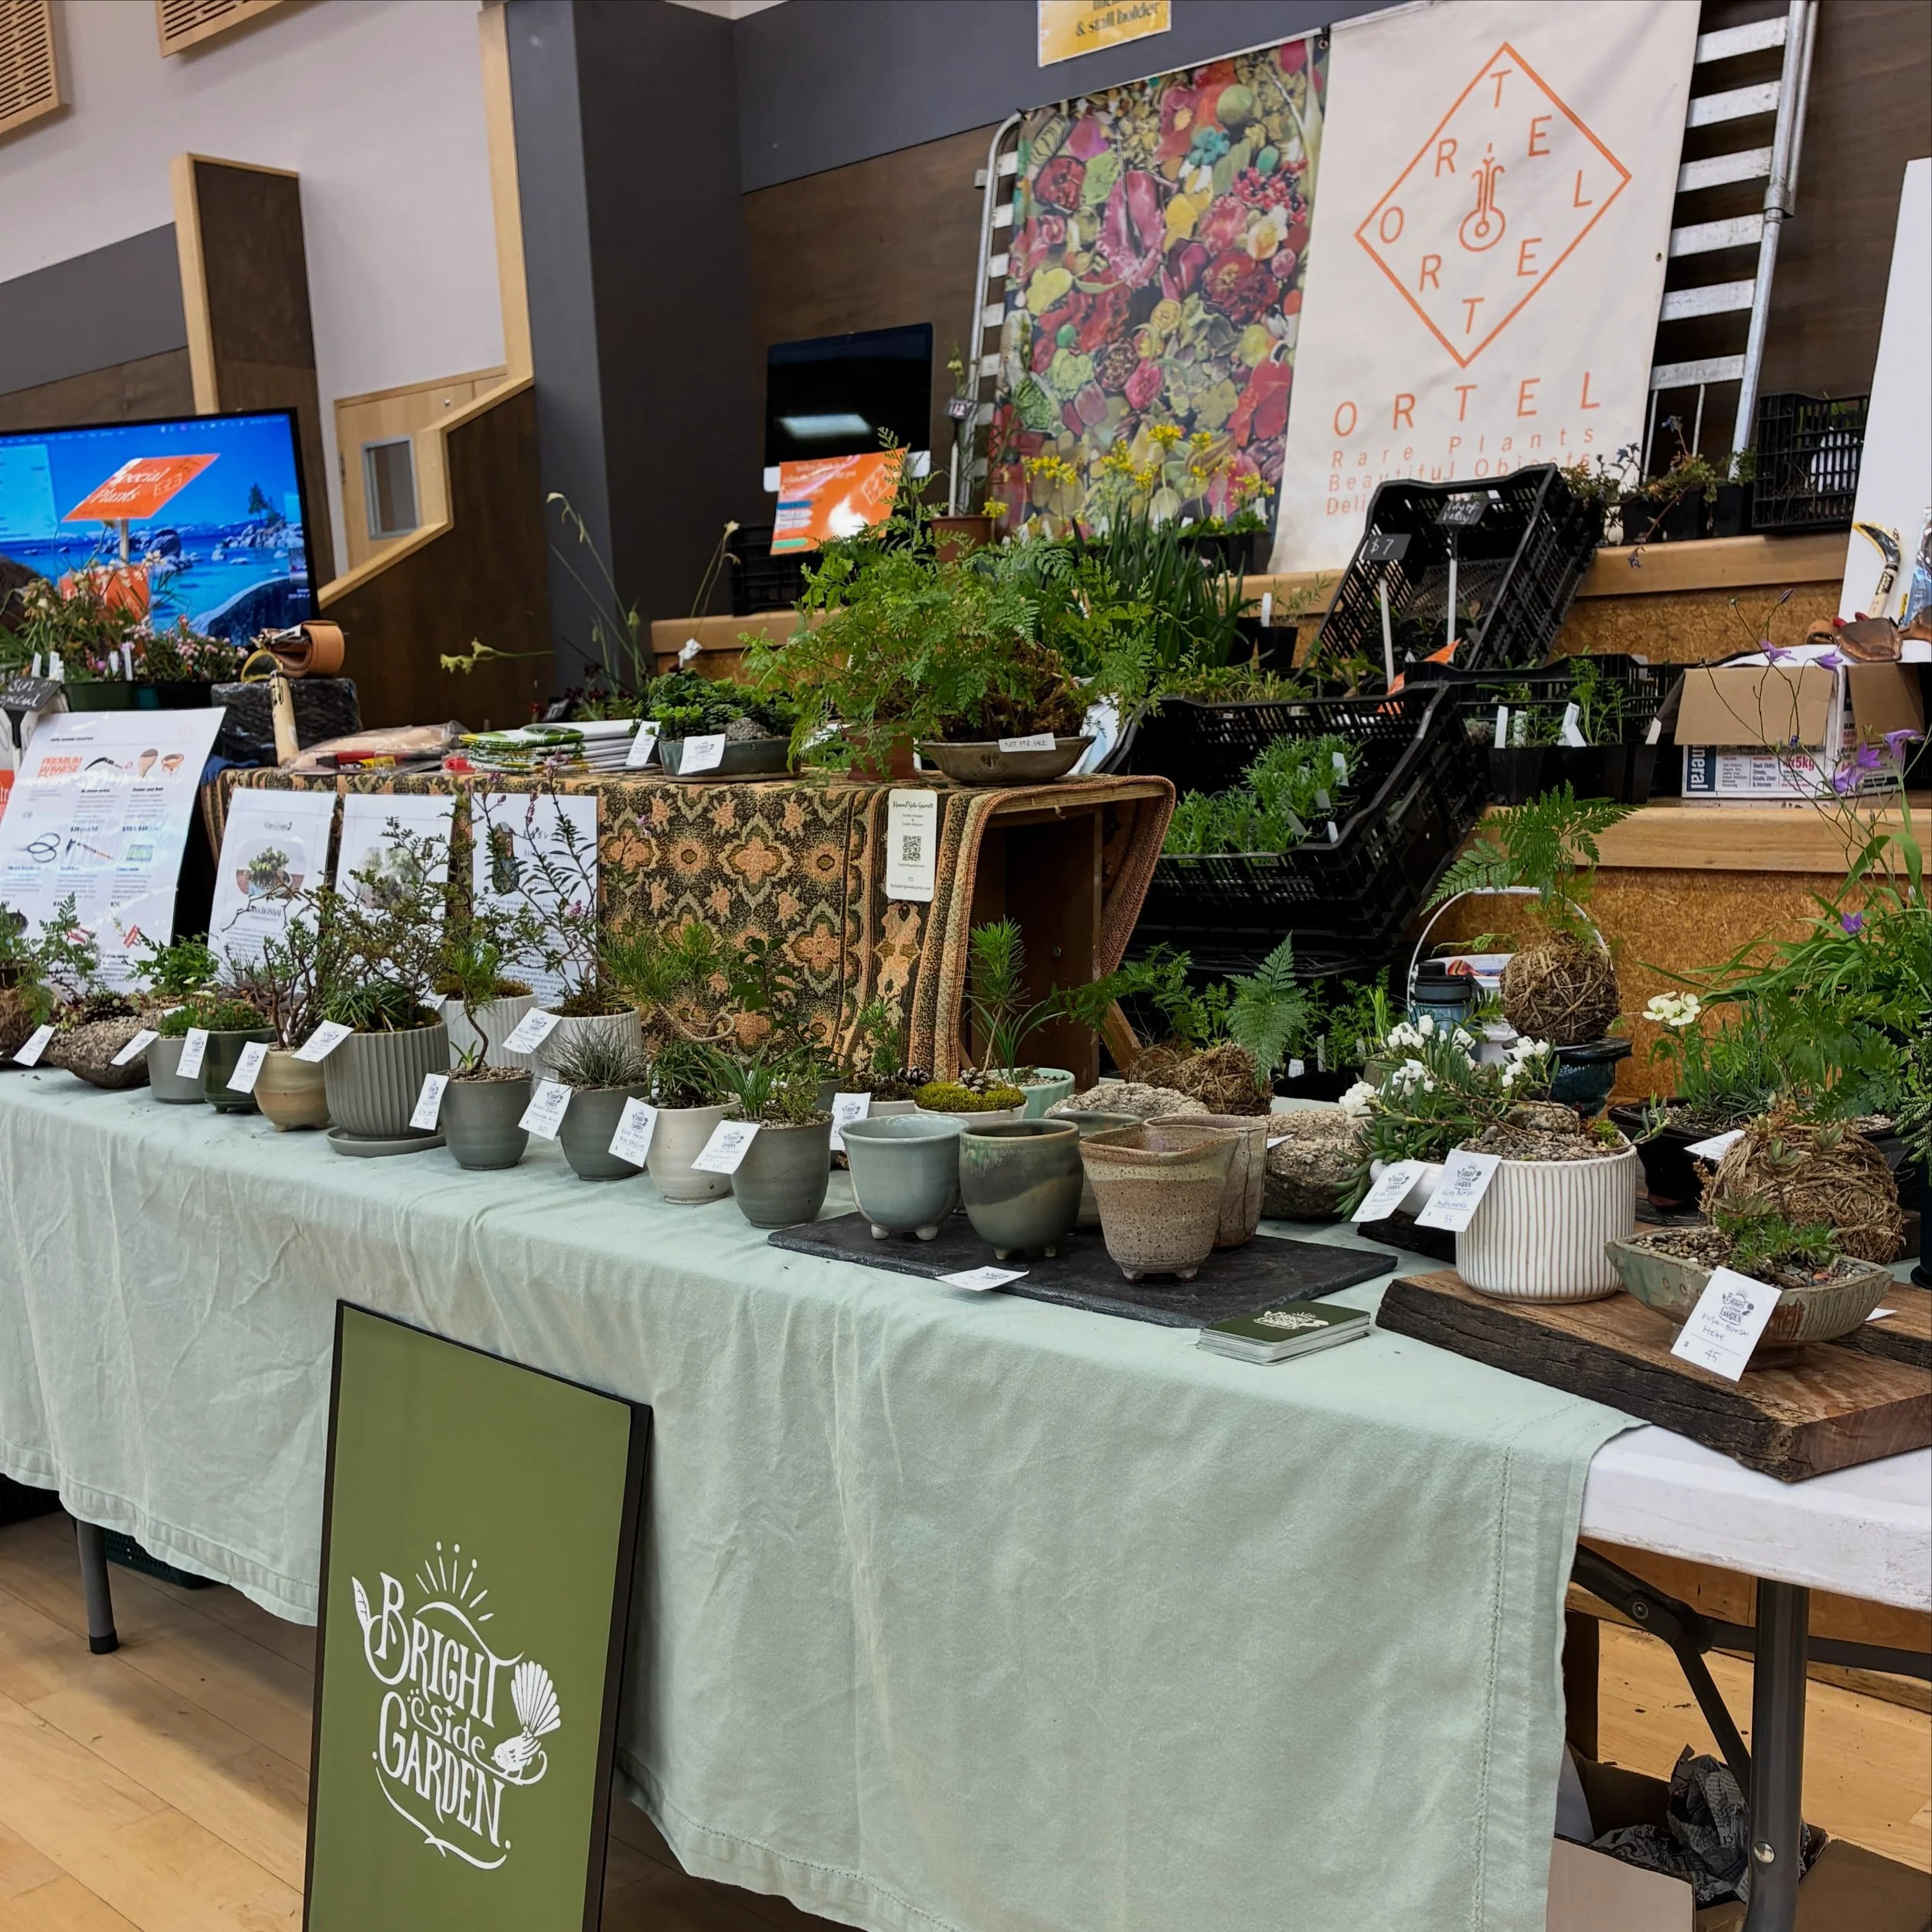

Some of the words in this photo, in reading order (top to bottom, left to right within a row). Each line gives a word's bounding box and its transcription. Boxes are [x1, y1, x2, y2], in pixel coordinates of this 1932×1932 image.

[1333, 371, 1601, 437] ORTEL
[1332, 445, 1414, 469] Rare
[1449, 427, 1594, 454] Plants
[1705, 1349, 1723, 1363] 45
[363, 1570, 515, 1728] BRIGHT
[379, 1691, 505, 1849] GARDEN
